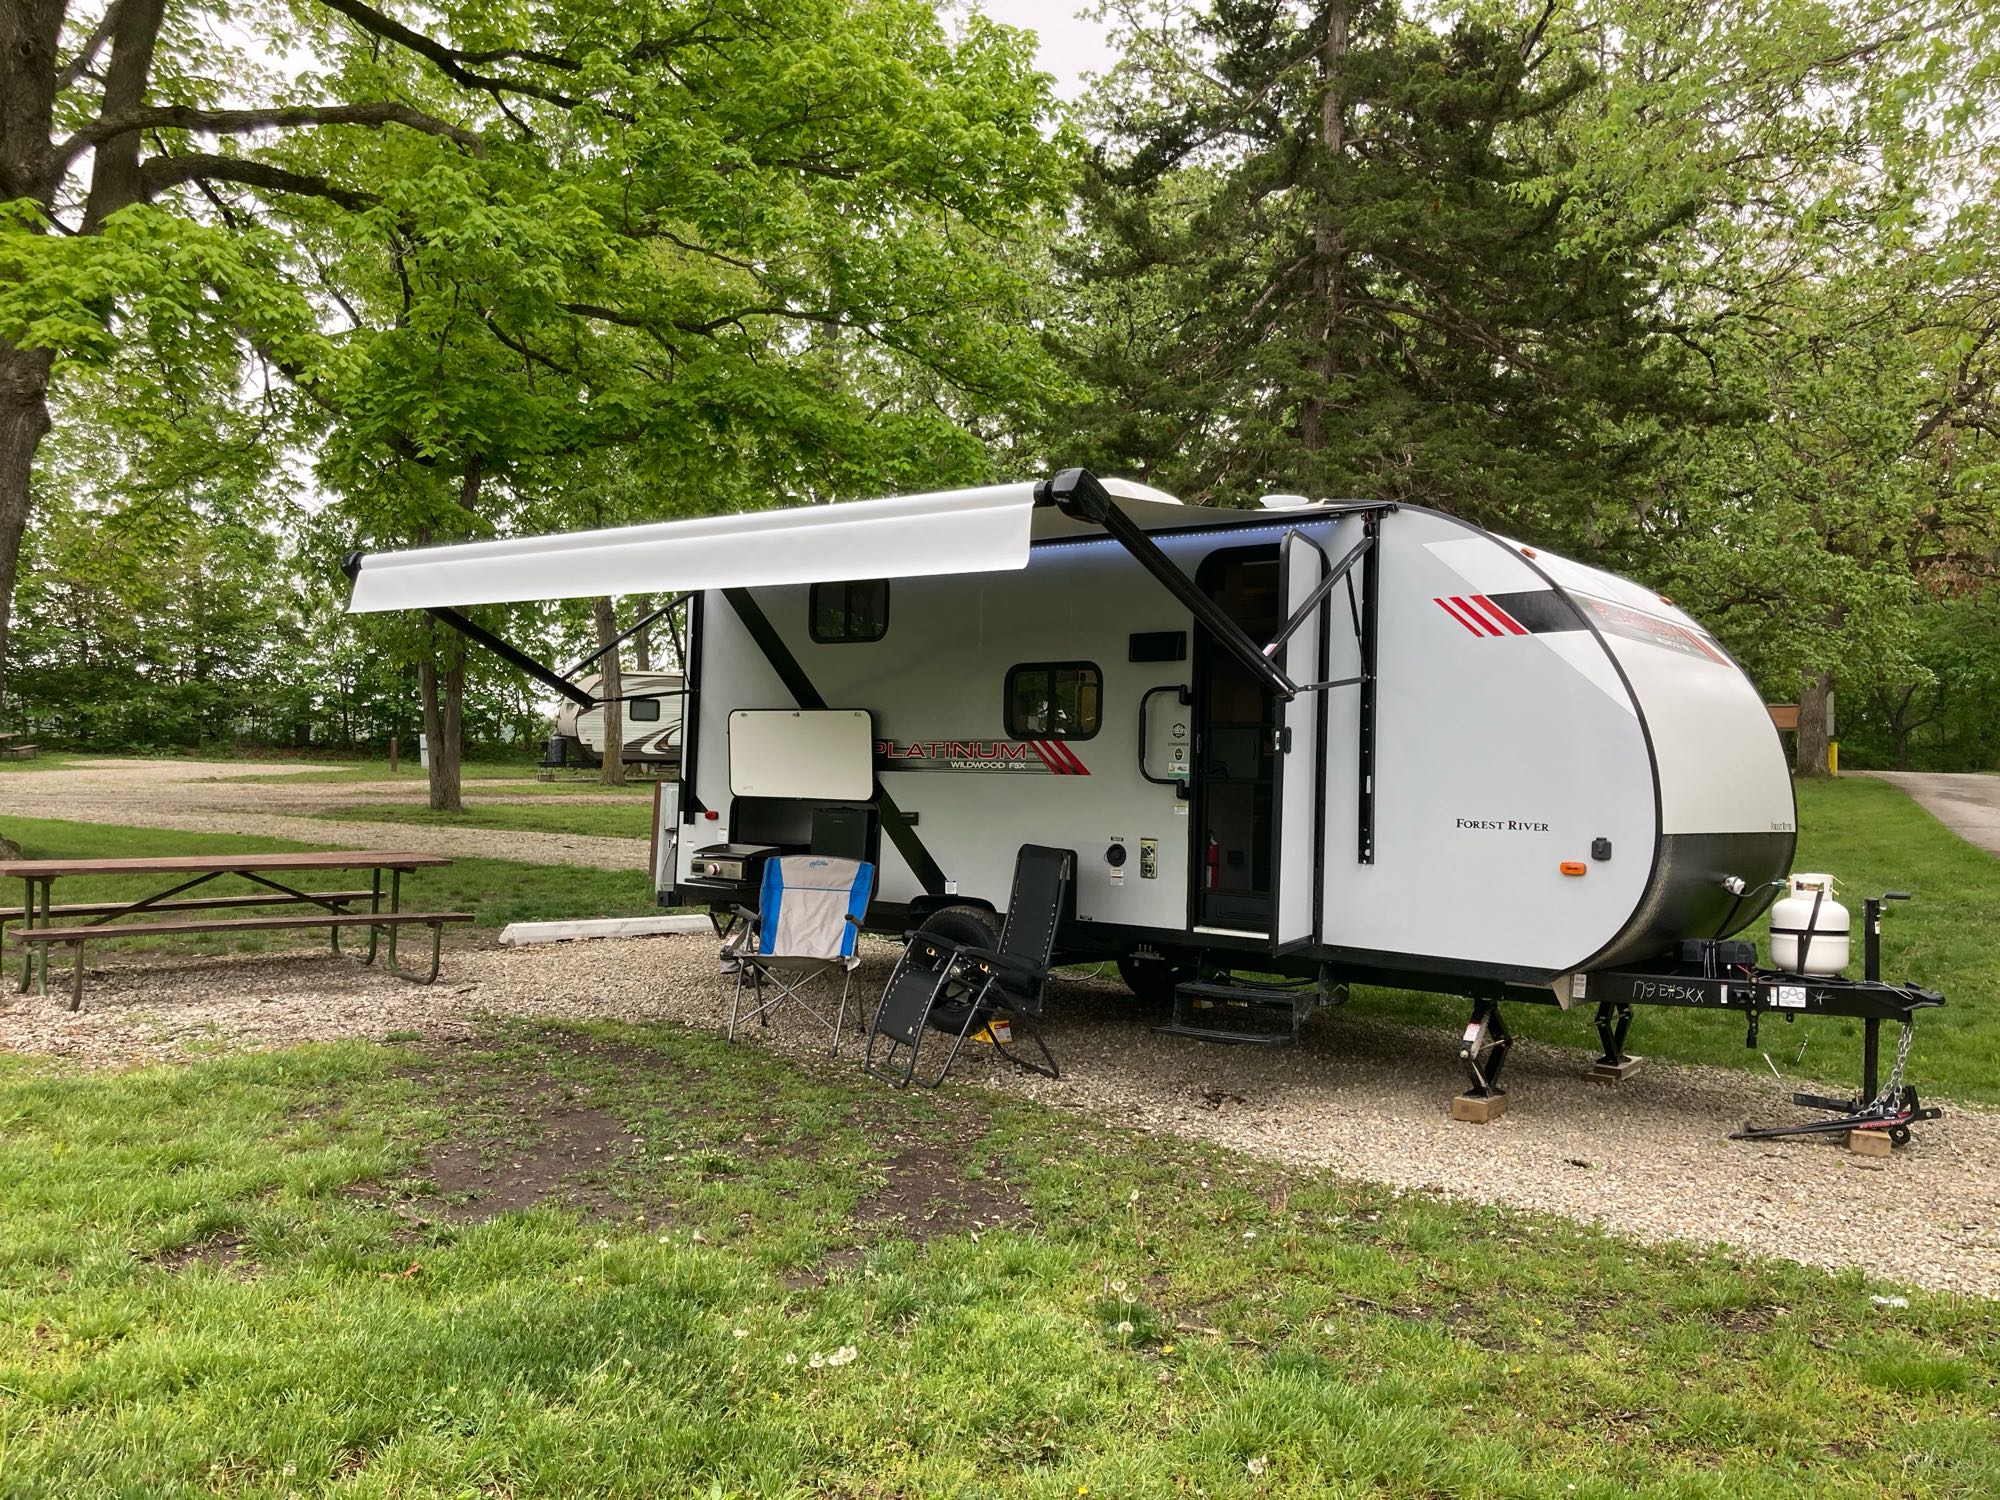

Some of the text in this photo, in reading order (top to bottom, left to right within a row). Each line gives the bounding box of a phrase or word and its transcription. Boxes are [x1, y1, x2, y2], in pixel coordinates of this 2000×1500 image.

[950, 761, 1006, 769] WILDWOOD
[1456, 818, 1550, 832] FOREST RIVER
